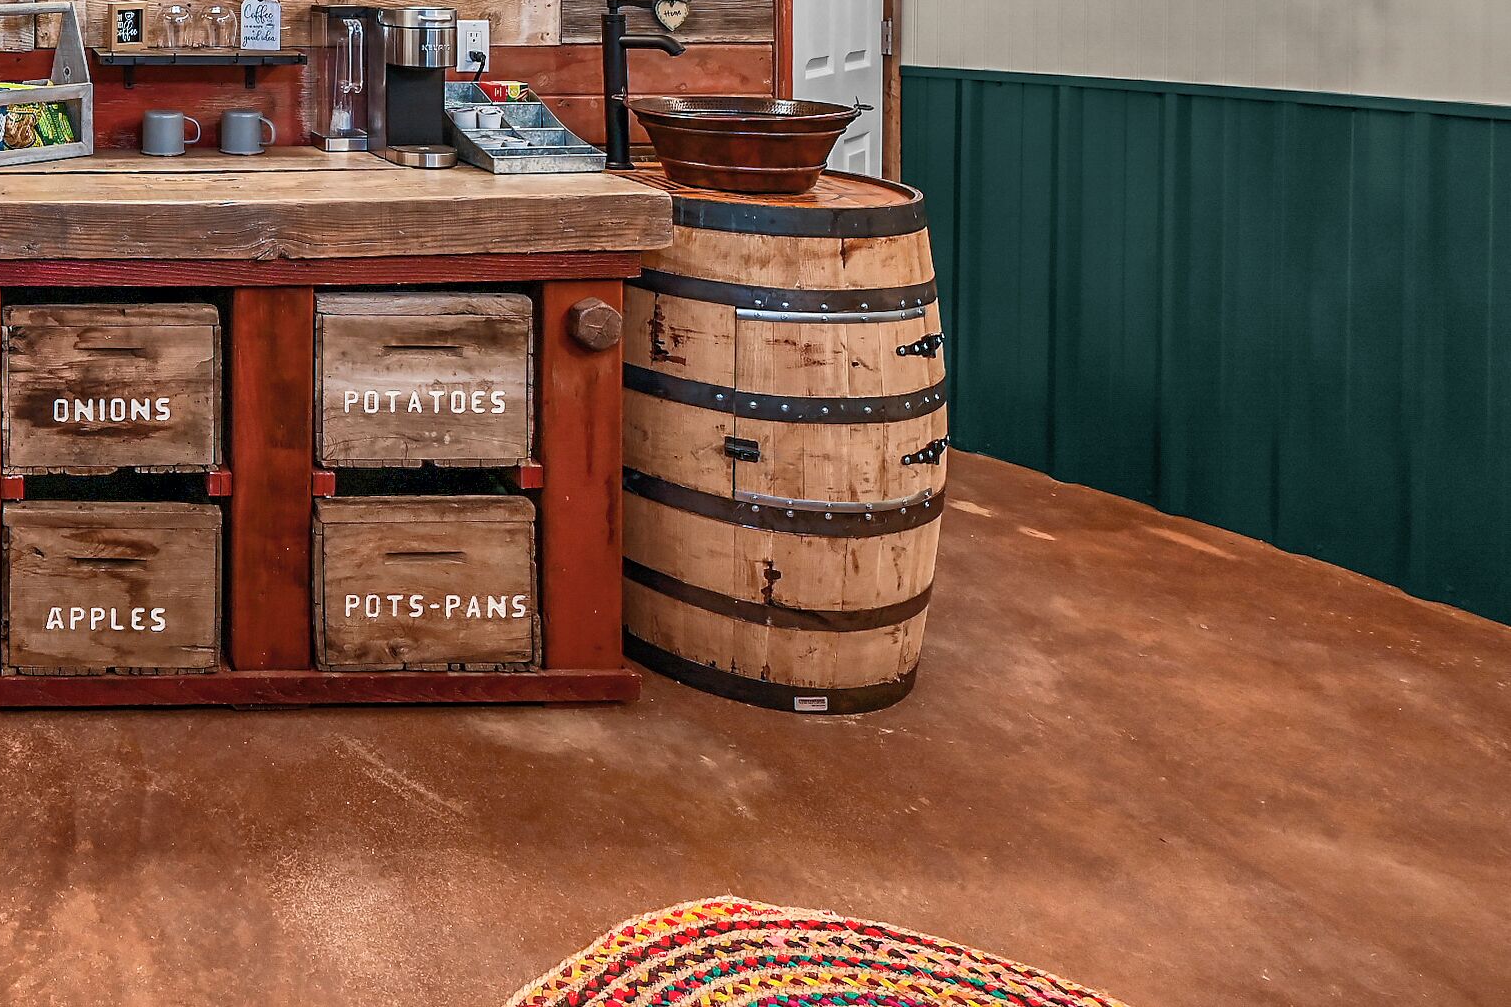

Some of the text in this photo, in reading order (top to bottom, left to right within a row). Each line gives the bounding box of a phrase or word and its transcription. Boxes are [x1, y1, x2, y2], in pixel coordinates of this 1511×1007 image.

[244, 4, 274, 24] Coffee
[242, 30, 262, 47] good
[52, 397, 171, 422] ONIONS
[343, 390, 506, 414] POTATOES
[344, 594, 527, 619] POTS-PANS
[45, 606, 167, 632] APPLES
